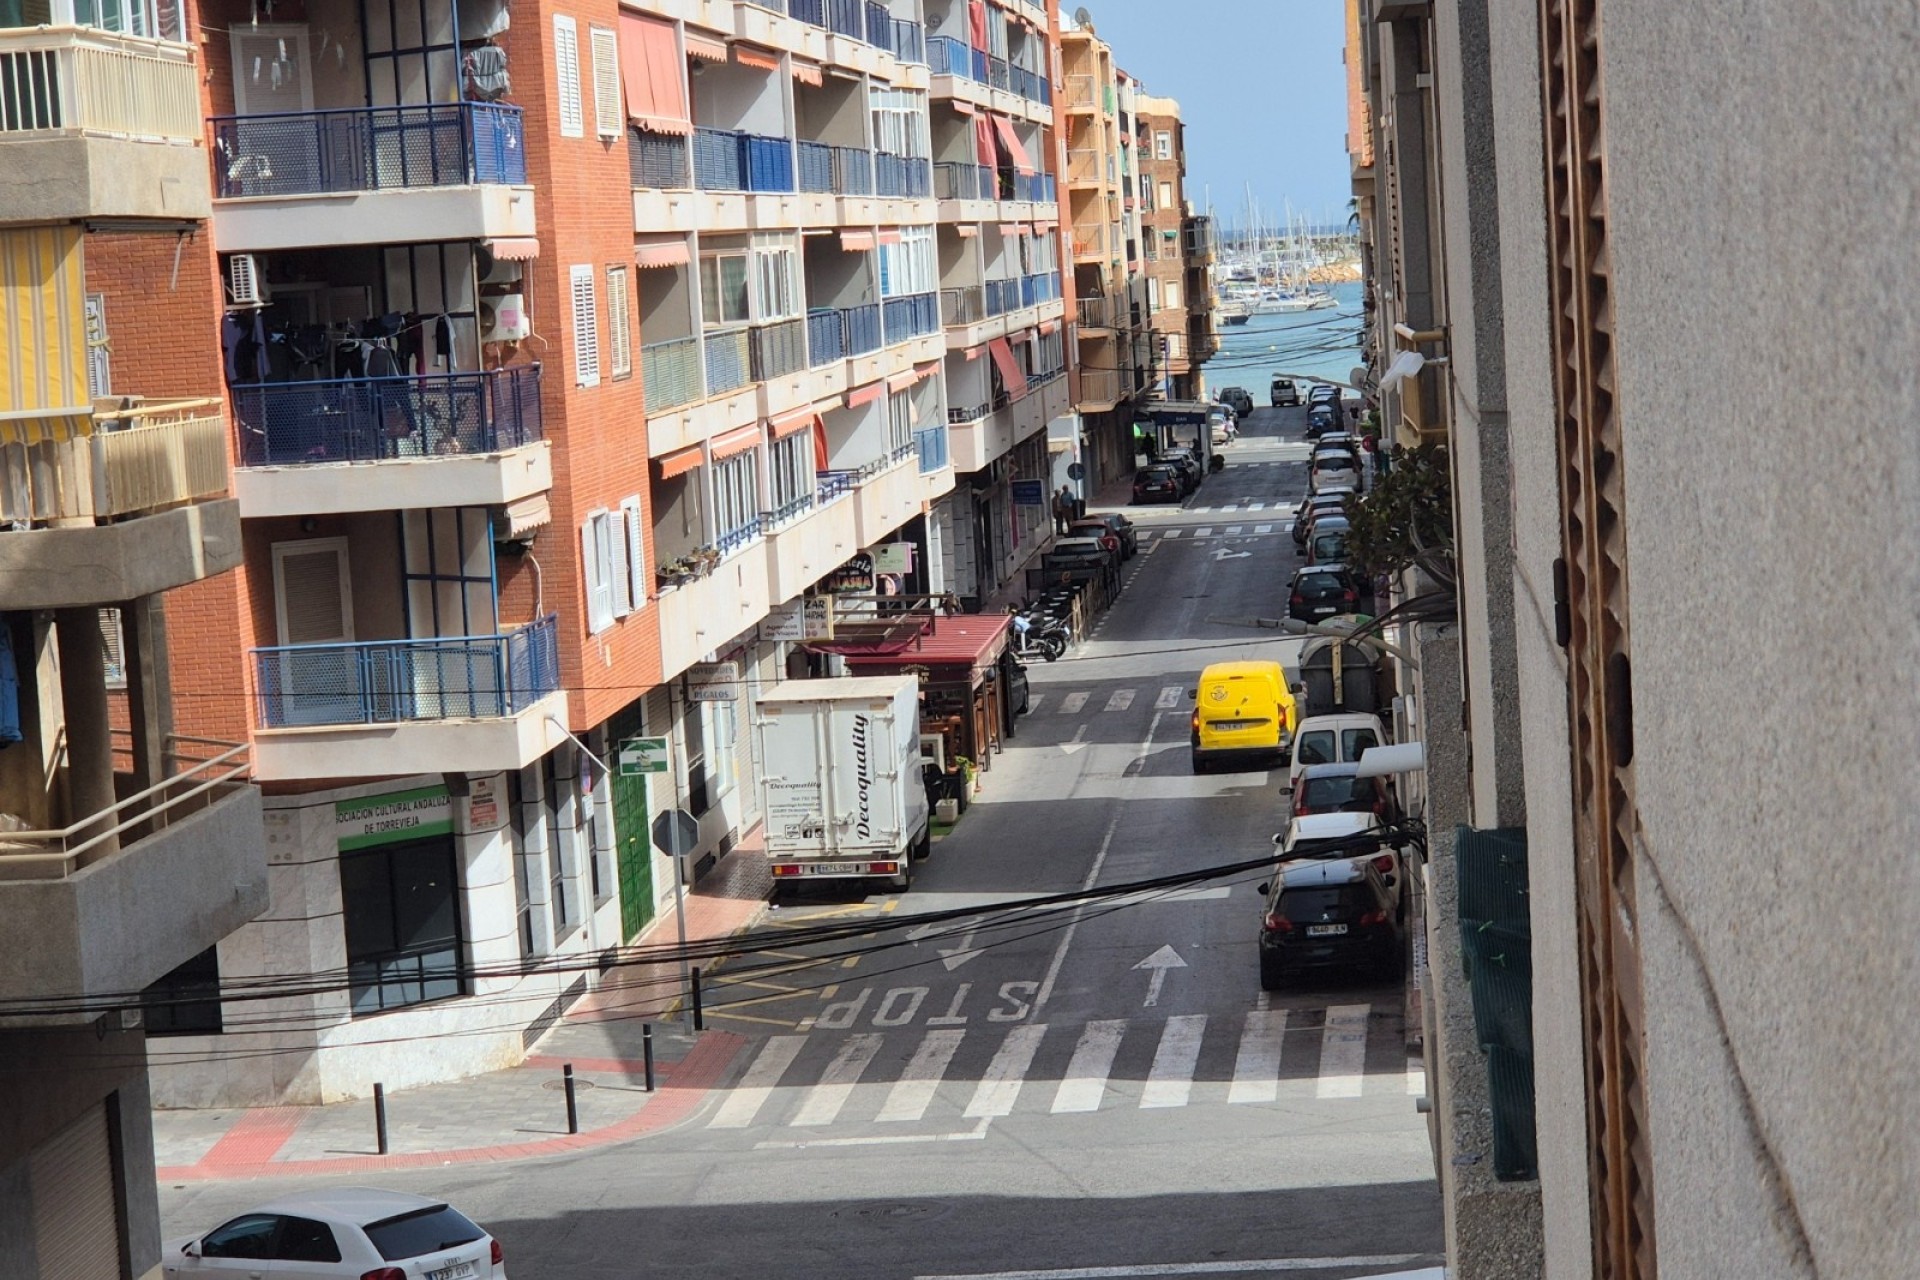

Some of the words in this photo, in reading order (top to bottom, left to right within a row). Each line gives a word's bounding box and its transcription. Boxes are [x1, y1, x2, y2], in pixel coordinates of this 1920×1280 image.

[694, 690, 729, 699] REGALOS
[853, 714, 872, 840] Decoquality
[375, 802, 411, 817] CULTURAL
[413, 795, 451, 810] ANDALUZA
[364, 823, 374, 834] DE
[376, 816, 420, 832] TORREVIEJA
